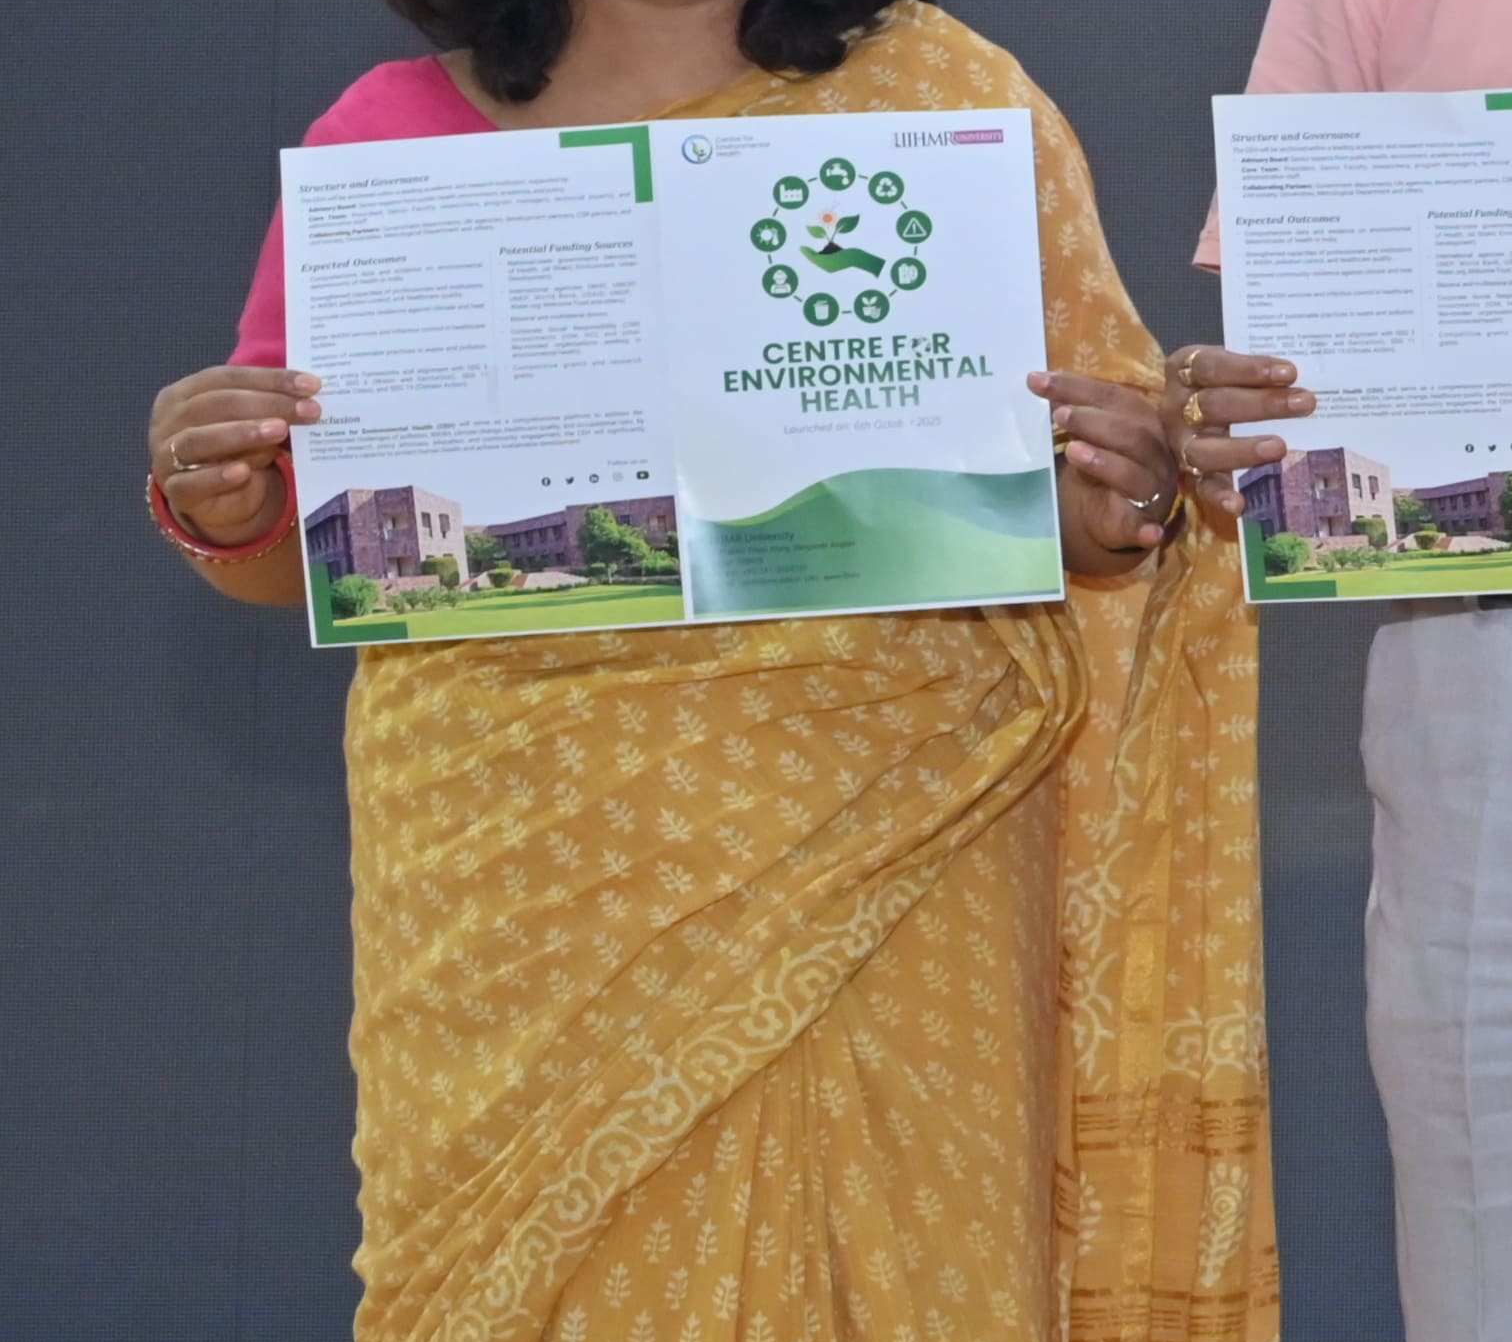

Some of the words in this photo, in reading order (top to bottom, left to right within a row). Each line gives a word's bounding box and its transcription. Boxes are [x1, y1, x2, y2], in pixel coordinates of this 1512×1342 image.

[955, 131, 1002, 144] UNIVERSITY
[1231, 133, 1279, 143] Structure
[1281, 133, 1299, 141] and
[1302, 131, 1361, 140] Governance
[299, 182, 349, 194] Structure
[352, 179, 369, 190] and
[370, 174, 429, 187] Governance
[1235, 216, 1284, 227] Expected
[1287, 215, 1341, 225] Outcomes
[1427, 209, 1473, 219] Potential
[499, 243, 547, 256] Potential
[549, 241, 592, 253] Funding
[594, 240, 633, 250] Sources
[301, 259, 349, 273] Expected
[353, 255, 407, 267] Outcomes
[762, 336, 884, 365] CENTRE
[723, 355, 994, 393] ENVIRONMENTAL
[801, 384, 921, 414] HEALTH
[784, 422, 832, 435] Launched
[854, 419, 871, 430] 6th
[916, 415, 942, 427] 2025
